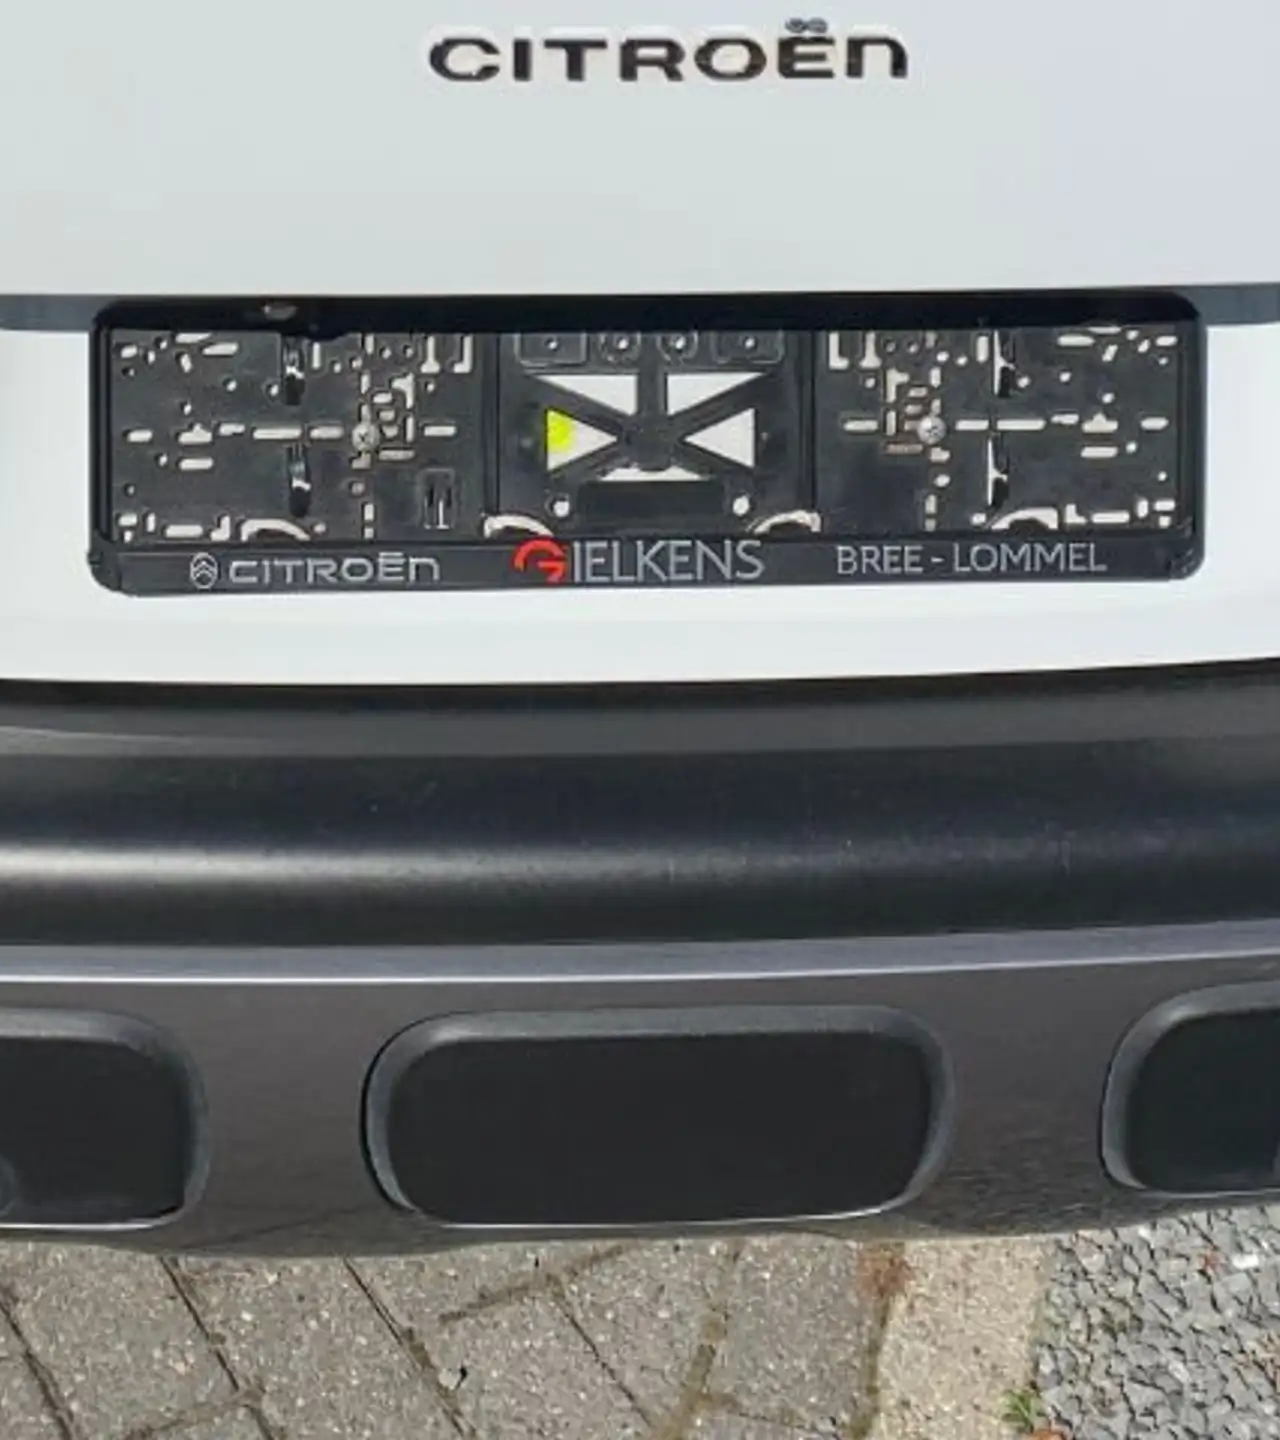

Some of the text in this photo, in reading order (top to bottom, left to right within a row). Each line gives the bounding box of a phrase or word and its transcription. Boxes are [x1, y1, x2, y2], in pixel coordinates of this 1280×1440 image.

[514, 539, 765, 584] GIELKENS
[837, 546, 923, 575] BREE
[953, 542, 1107, 573] LOMMEL
